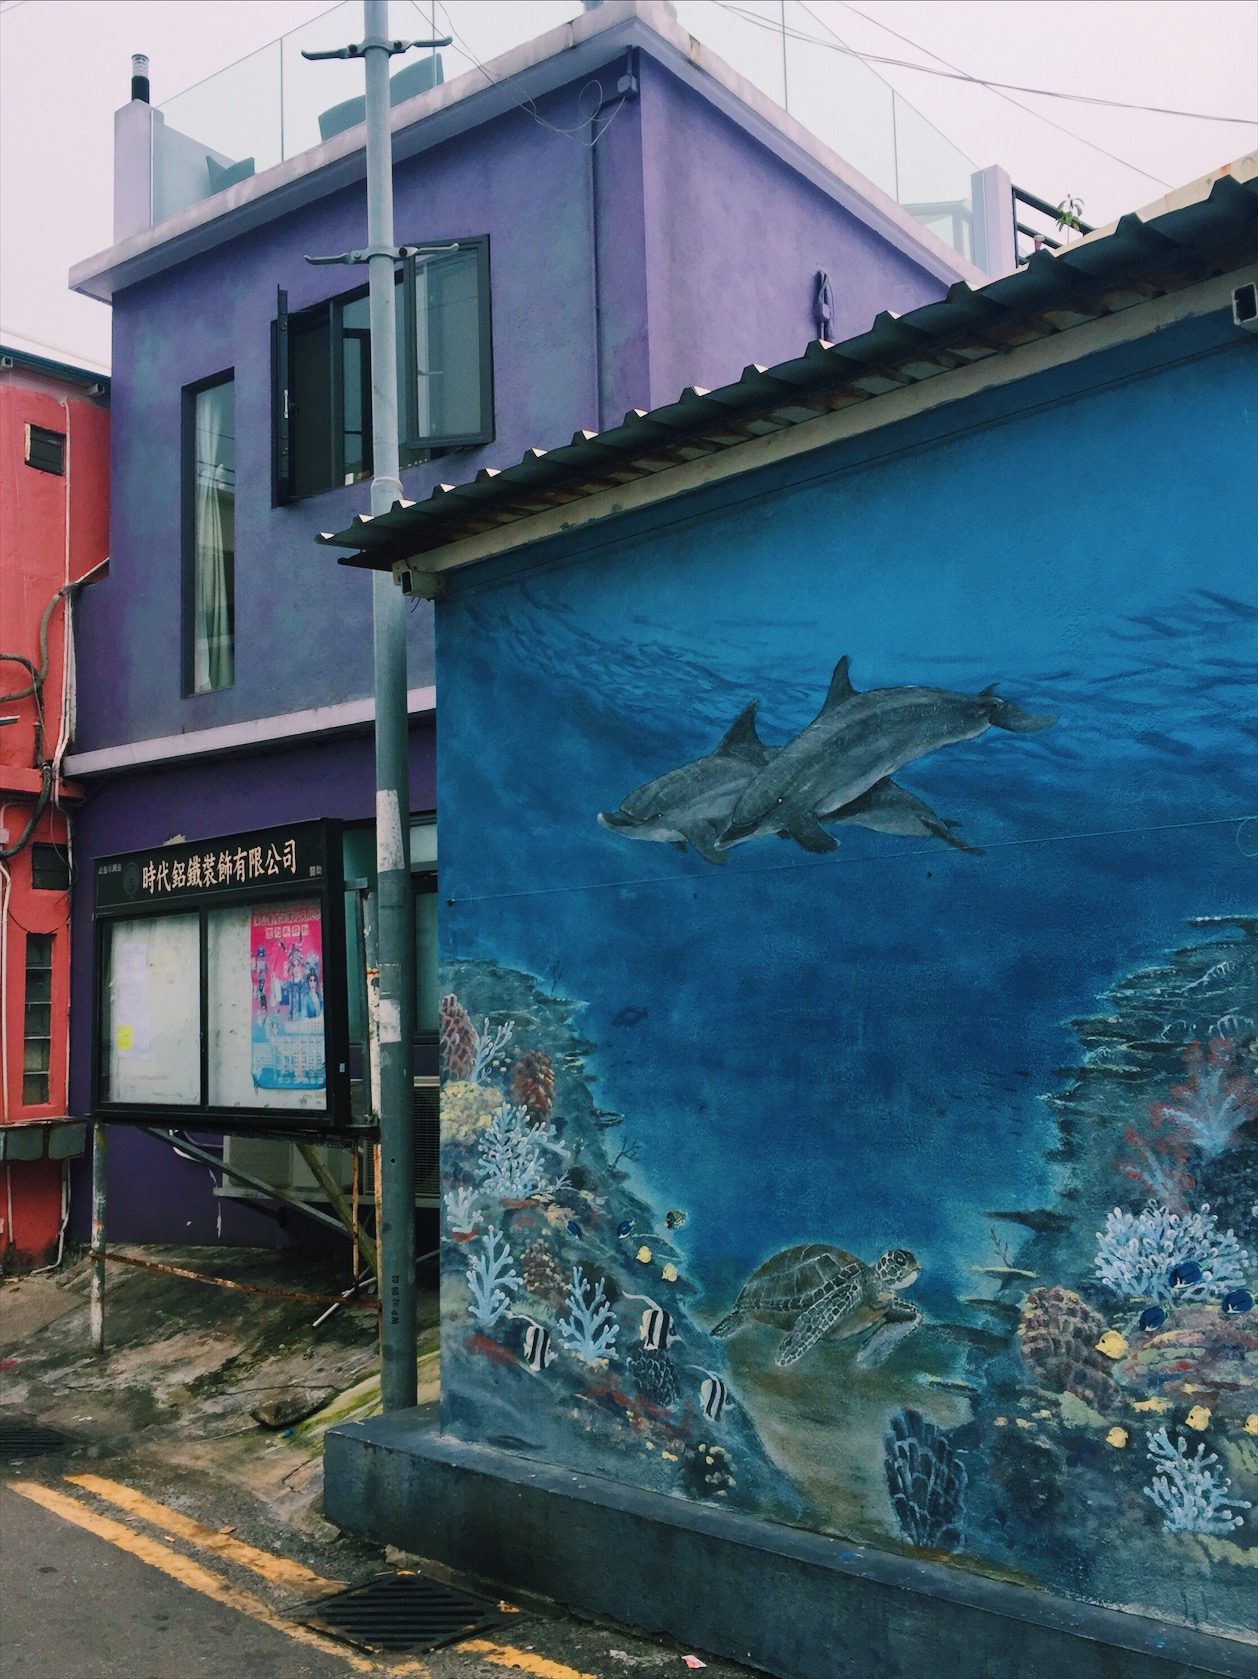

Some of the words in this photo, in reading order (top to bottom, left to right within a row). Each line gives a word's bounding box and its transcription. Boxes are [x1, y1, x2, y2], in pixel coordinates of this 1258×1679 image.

[142, 839, 297, 894] 時代鋁鐵裝飾有限公司
